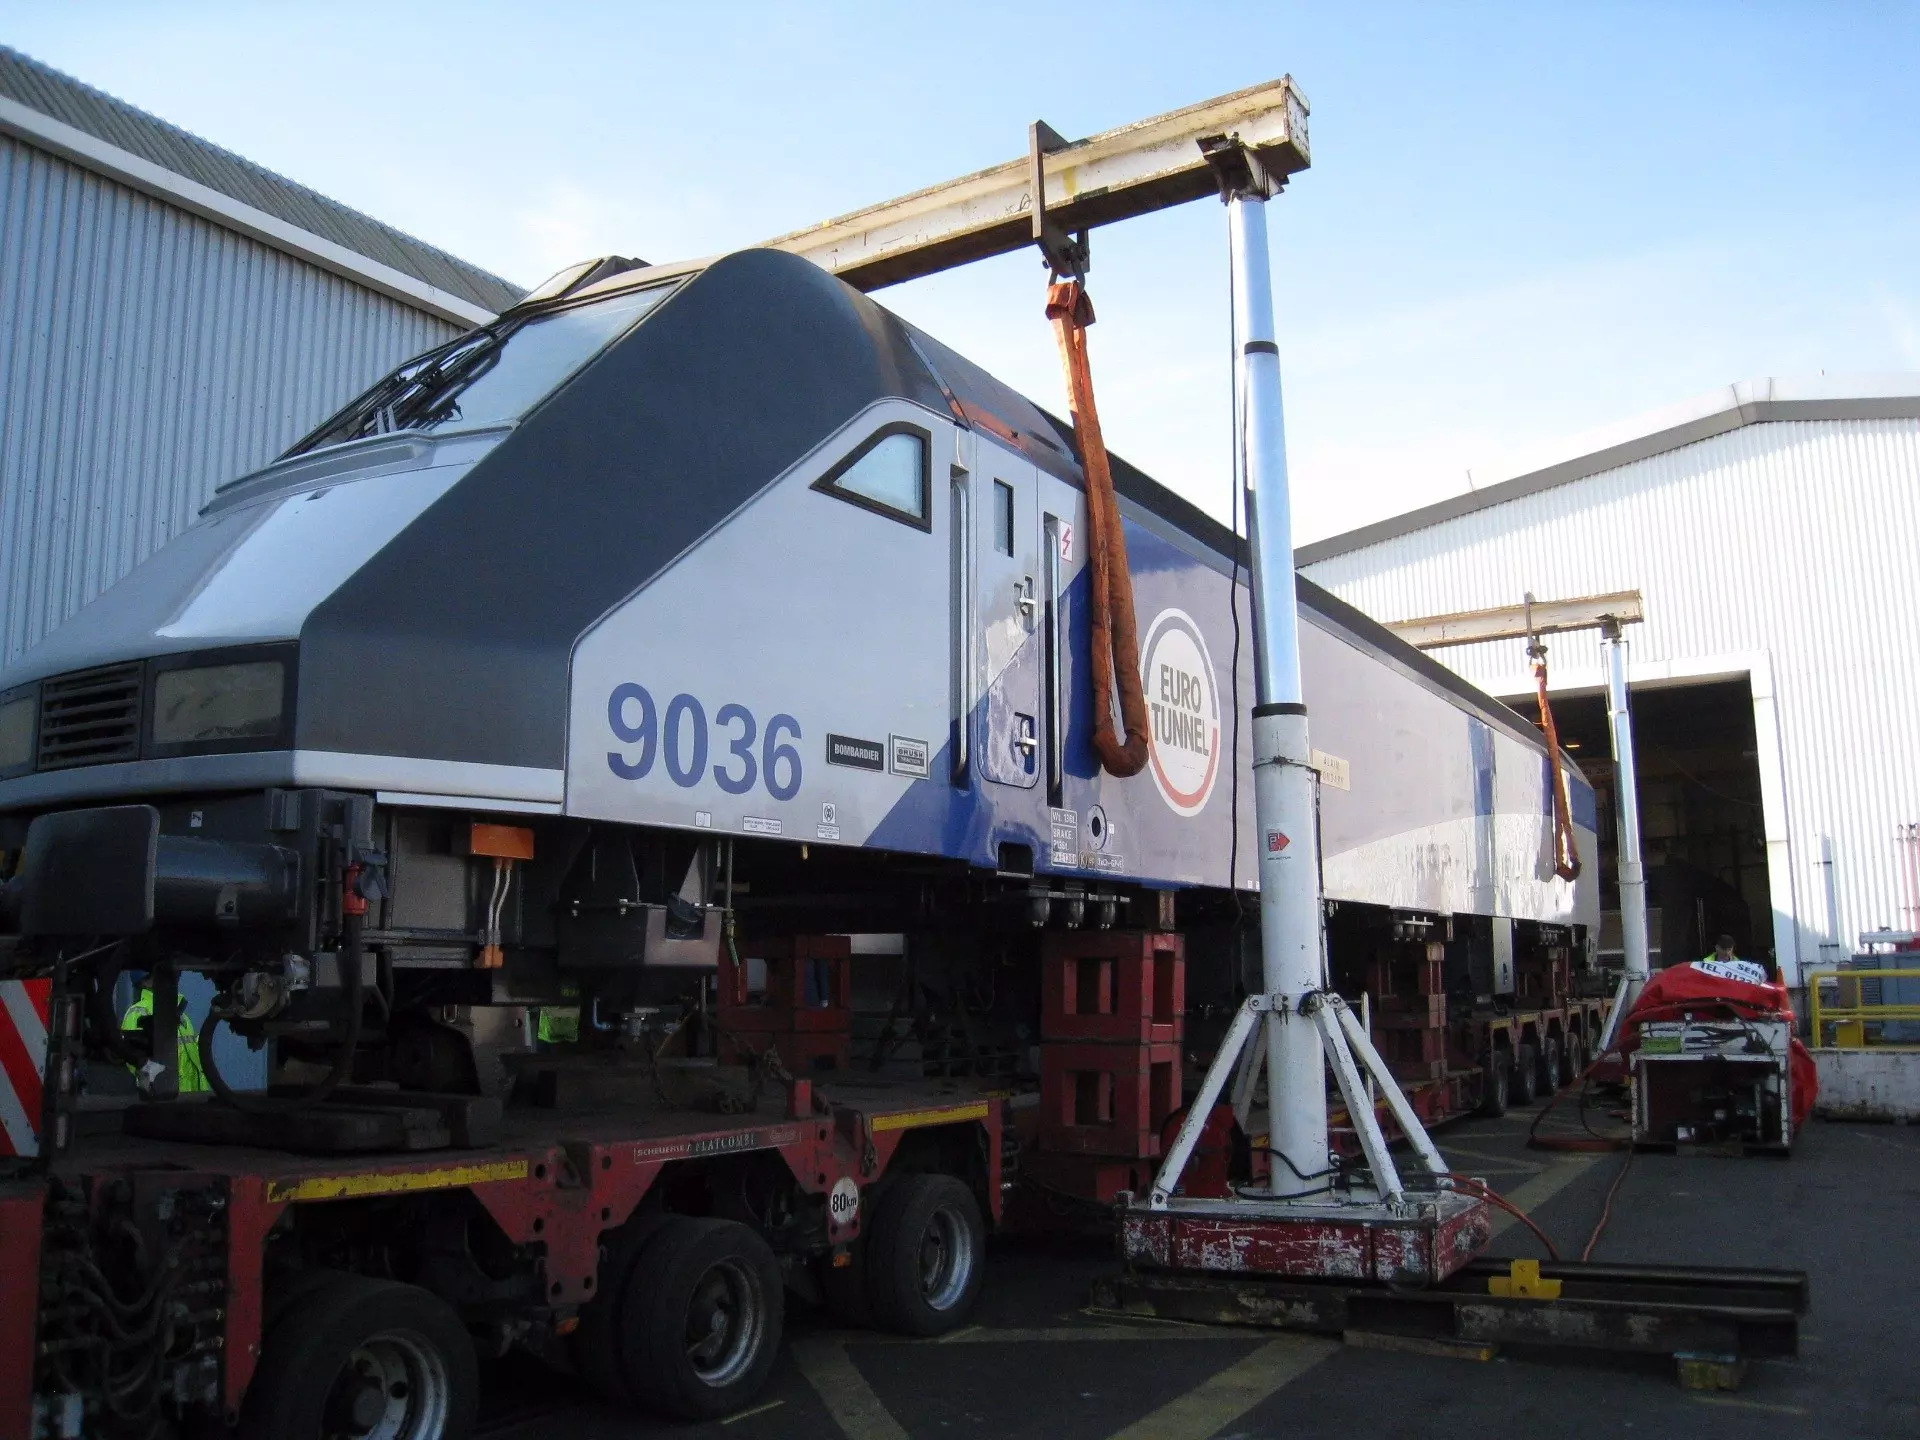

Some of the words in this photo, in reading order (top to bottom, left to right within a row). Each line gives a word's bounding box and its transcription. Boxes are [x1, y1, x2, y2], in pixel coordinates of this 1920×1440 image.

[1160, 663, 1202, 714] EURO
[606, 682, 803, 801] 9036
[1151, 702, 1210, 757] TUNNEL
[834, 743, 880, 762] BOMBARDIER
[897, 748, 924, 759] BRUSH
[1700, 962, 1721, 975] TEL.
